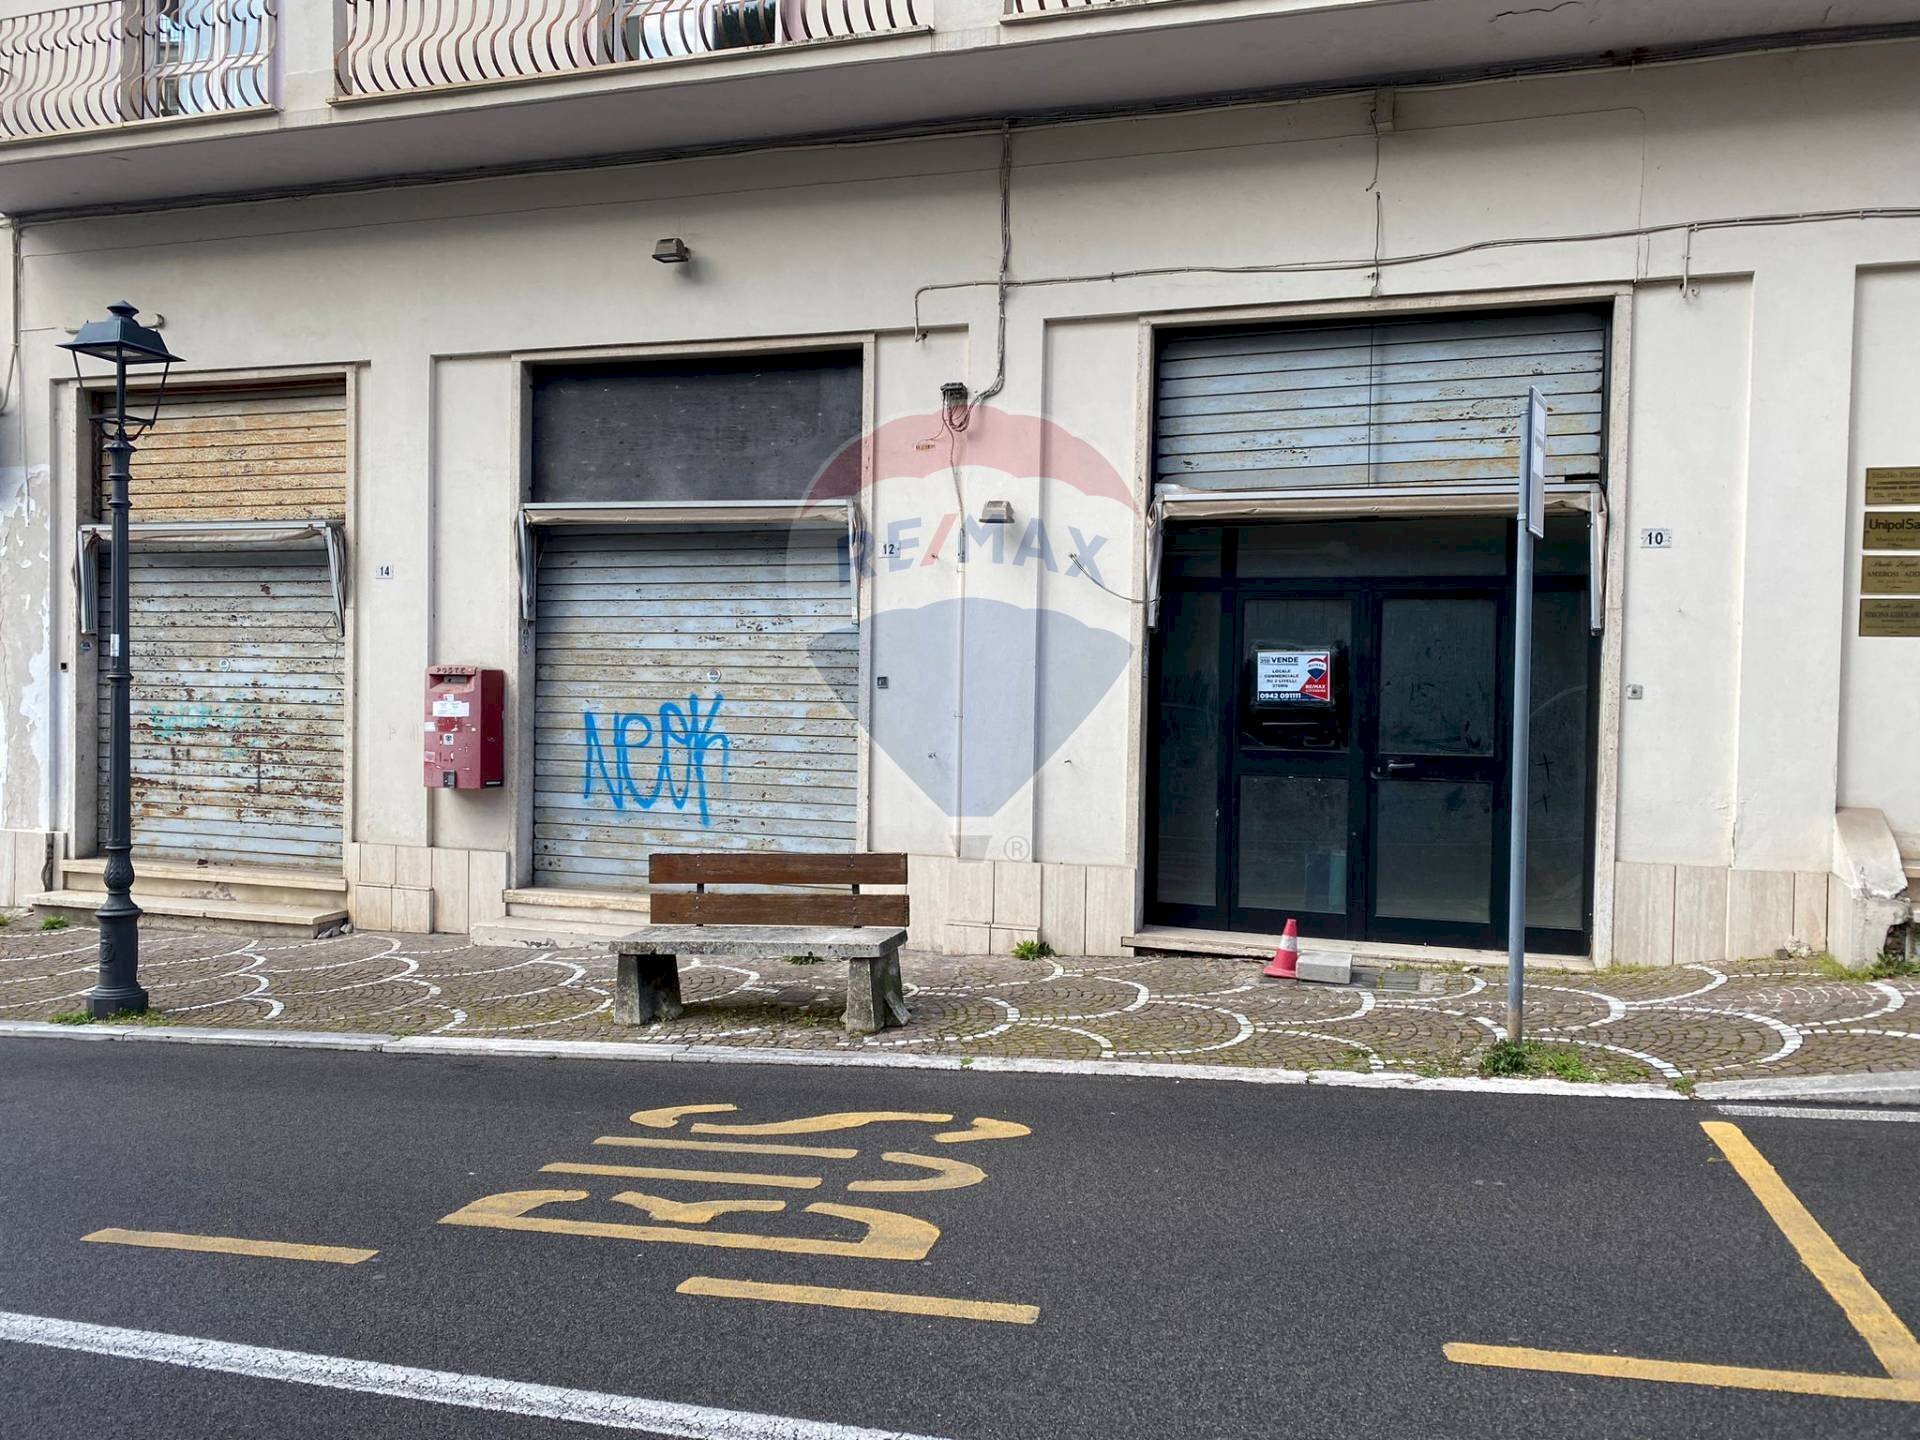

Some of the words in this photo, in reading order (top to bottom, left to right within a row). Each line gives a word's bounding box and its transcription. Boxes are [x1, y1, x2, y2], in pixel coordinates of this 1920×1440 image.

[1648, 531, 1663, 545] 10
[883, 543, 895, 555] 12
[379, 565, 390, 577] 14
[437, 1102, 1033, 1262] BUS
